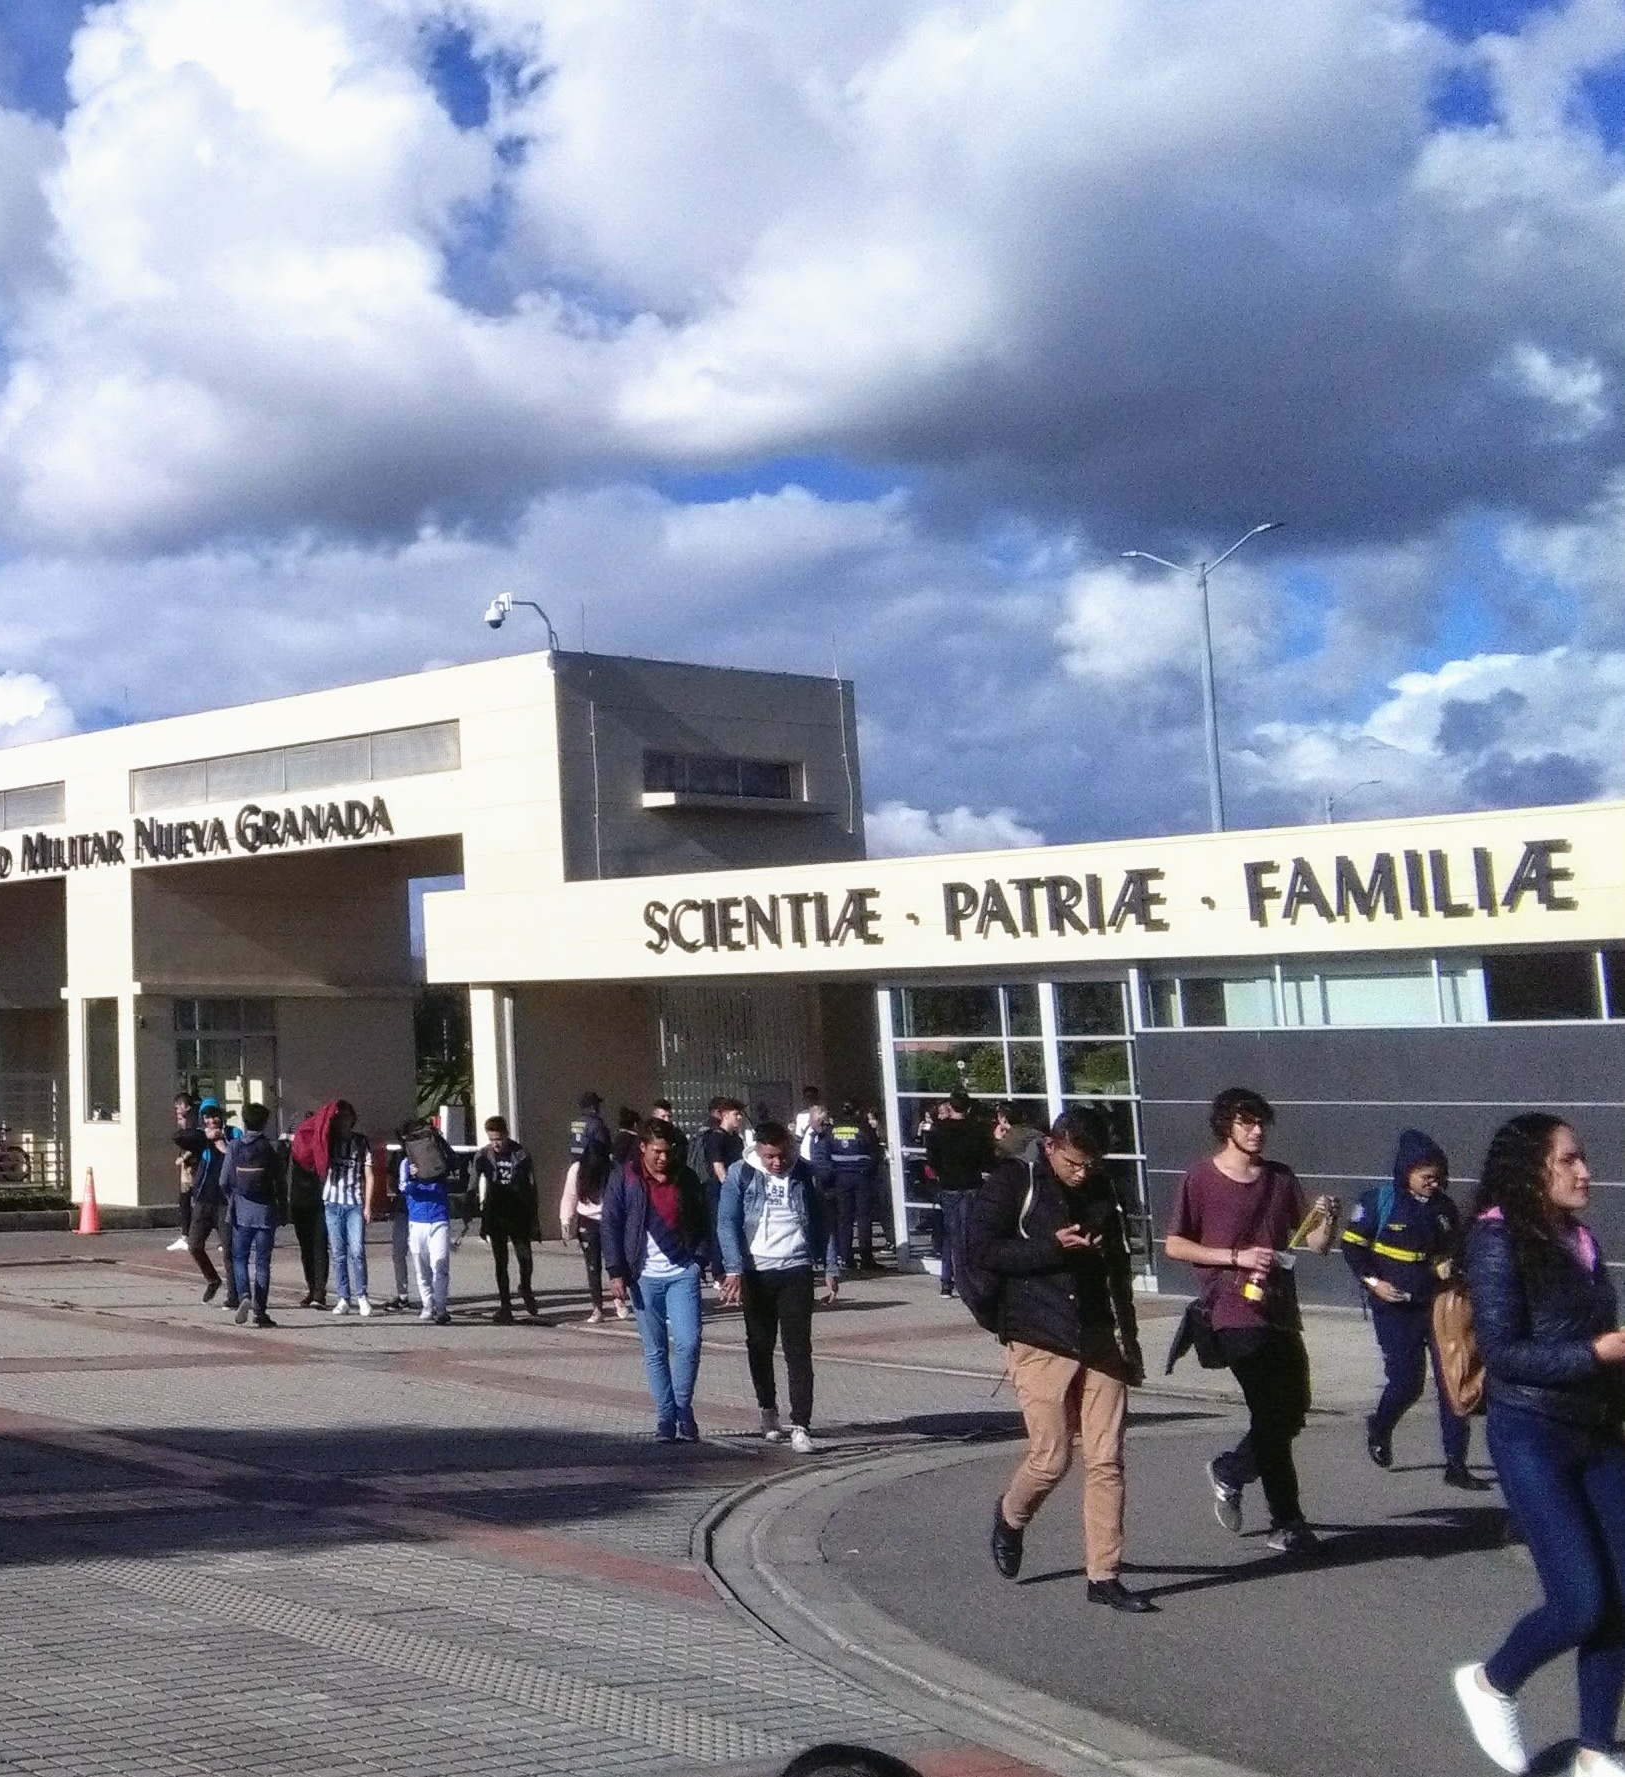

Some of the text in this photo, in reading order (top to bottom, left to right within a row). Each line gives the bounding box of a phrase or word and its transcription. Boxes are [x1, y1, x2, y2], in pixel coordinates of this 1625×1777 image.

[21, 831, 125, 876] MILITAR
[133, 817, 231, 863] NUEVA
[235, 796, 394, 852] GRANADA
